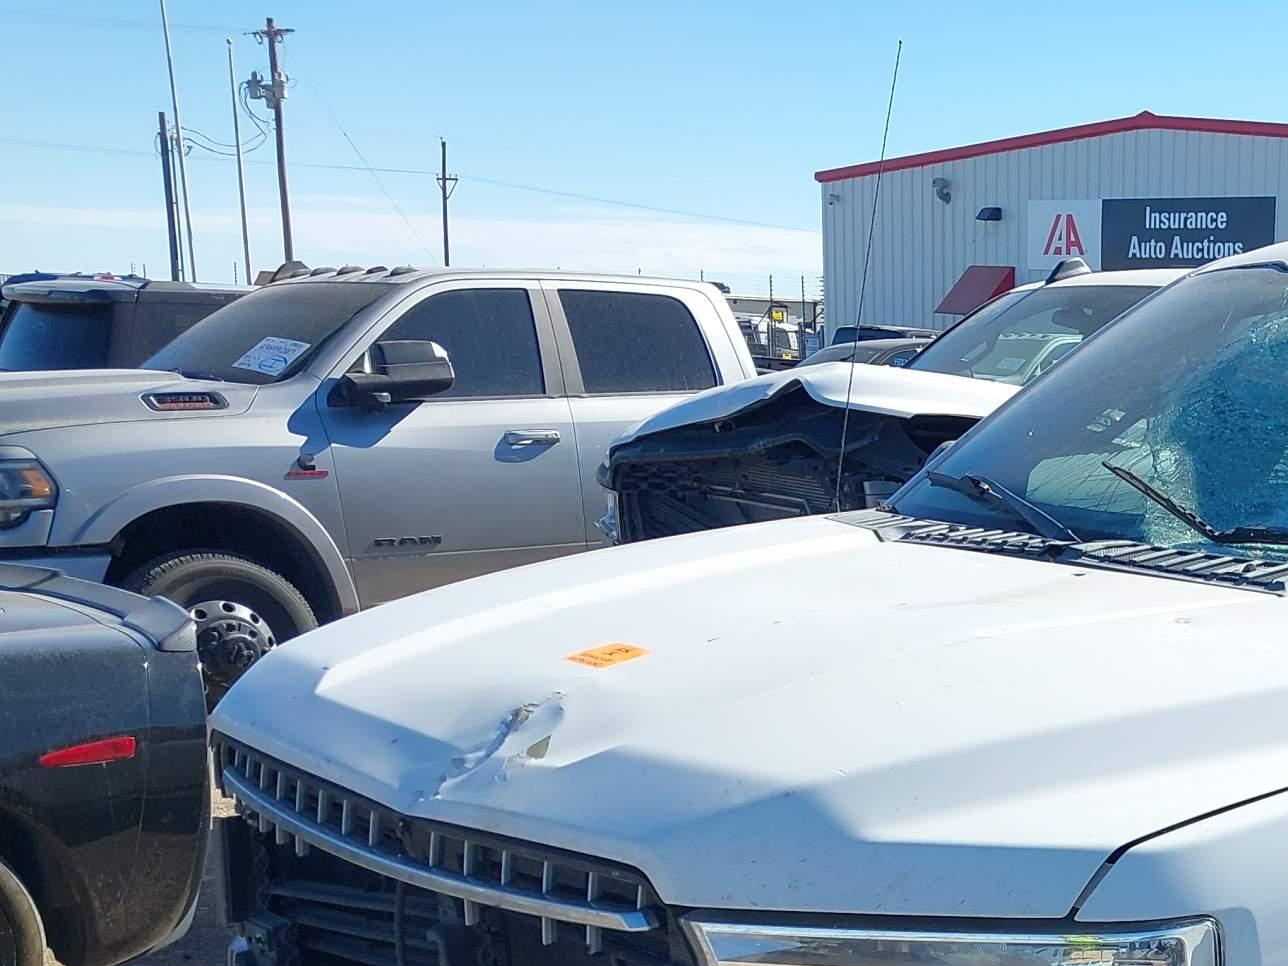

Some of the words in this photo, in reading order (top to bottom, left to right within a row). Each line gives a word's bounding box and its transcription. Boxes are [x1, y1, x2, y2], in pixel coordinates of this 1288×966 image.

[1145, 206, 1228, 230] Insurance
[1127, 235, 1166, 259] Auto
[1169, 234, 1244, 260] Auctions
[374, 534, 442, 547] RAM
